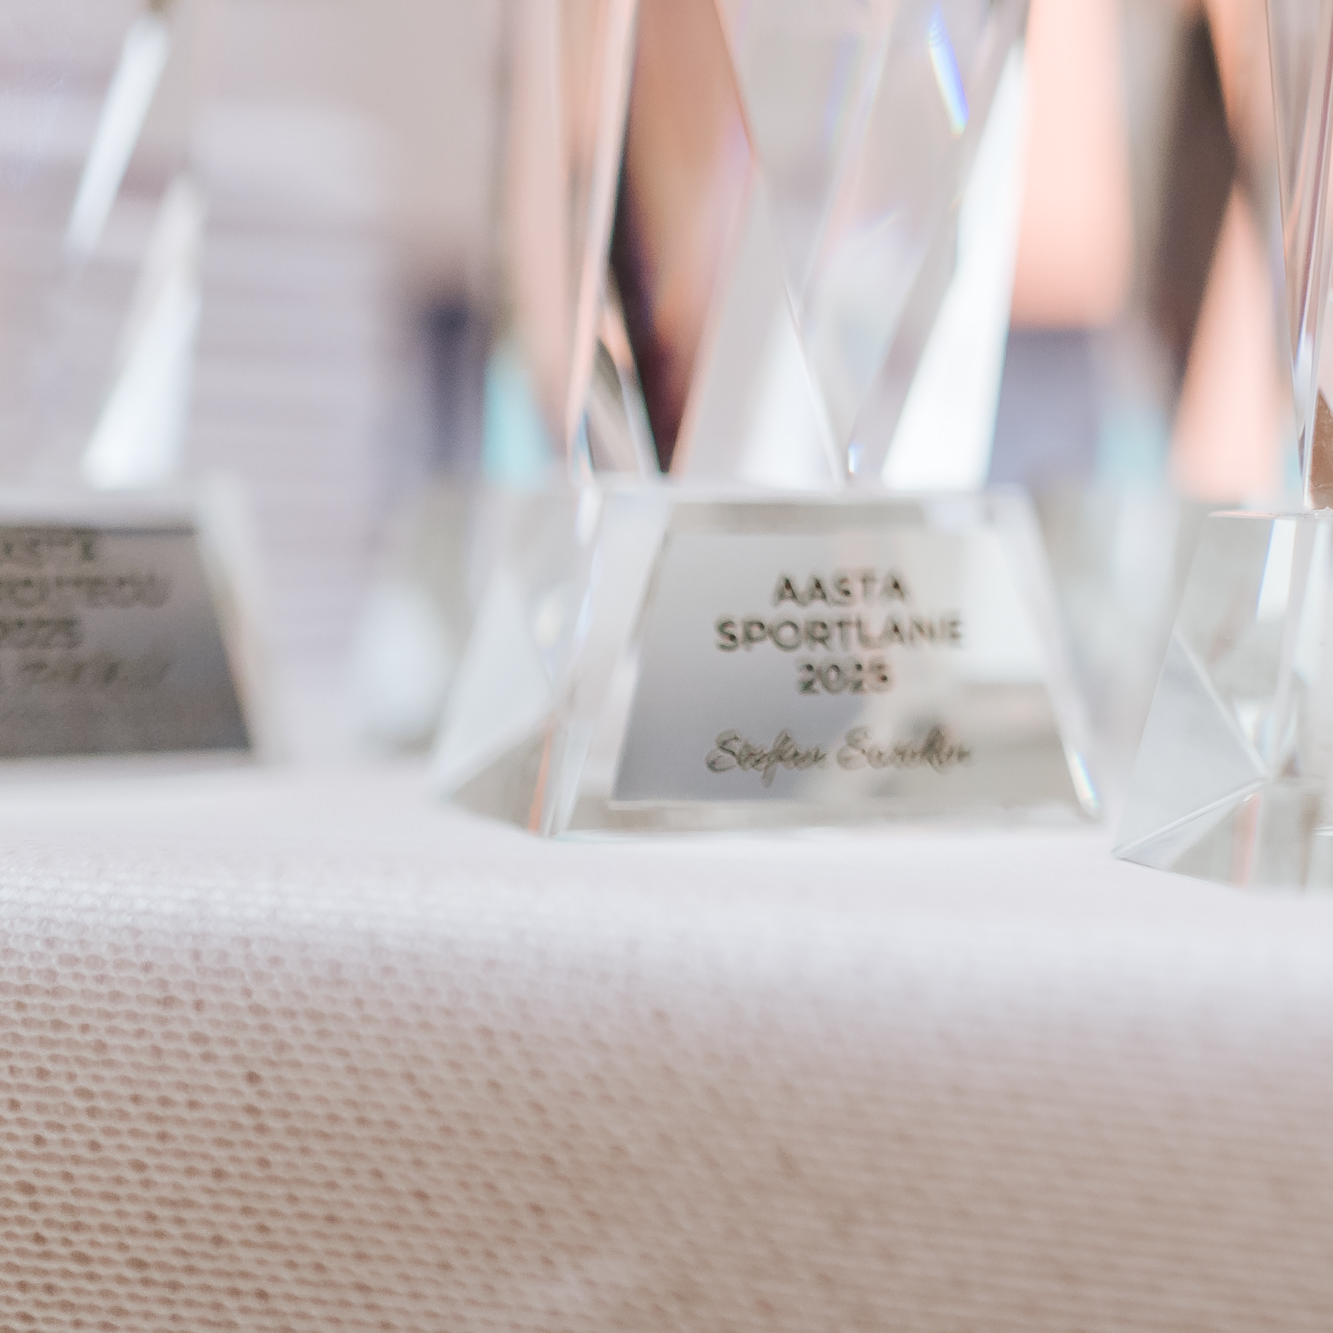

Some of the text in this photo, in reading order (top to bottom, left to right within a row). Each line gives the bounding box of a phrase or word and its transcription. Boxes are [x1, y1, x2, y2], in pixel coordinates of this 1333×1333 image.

[771, 570, 911, 607] AASTA
[714, 610, 963, 652] SPORTLANE
[797, 661, 893, 695] 2025
